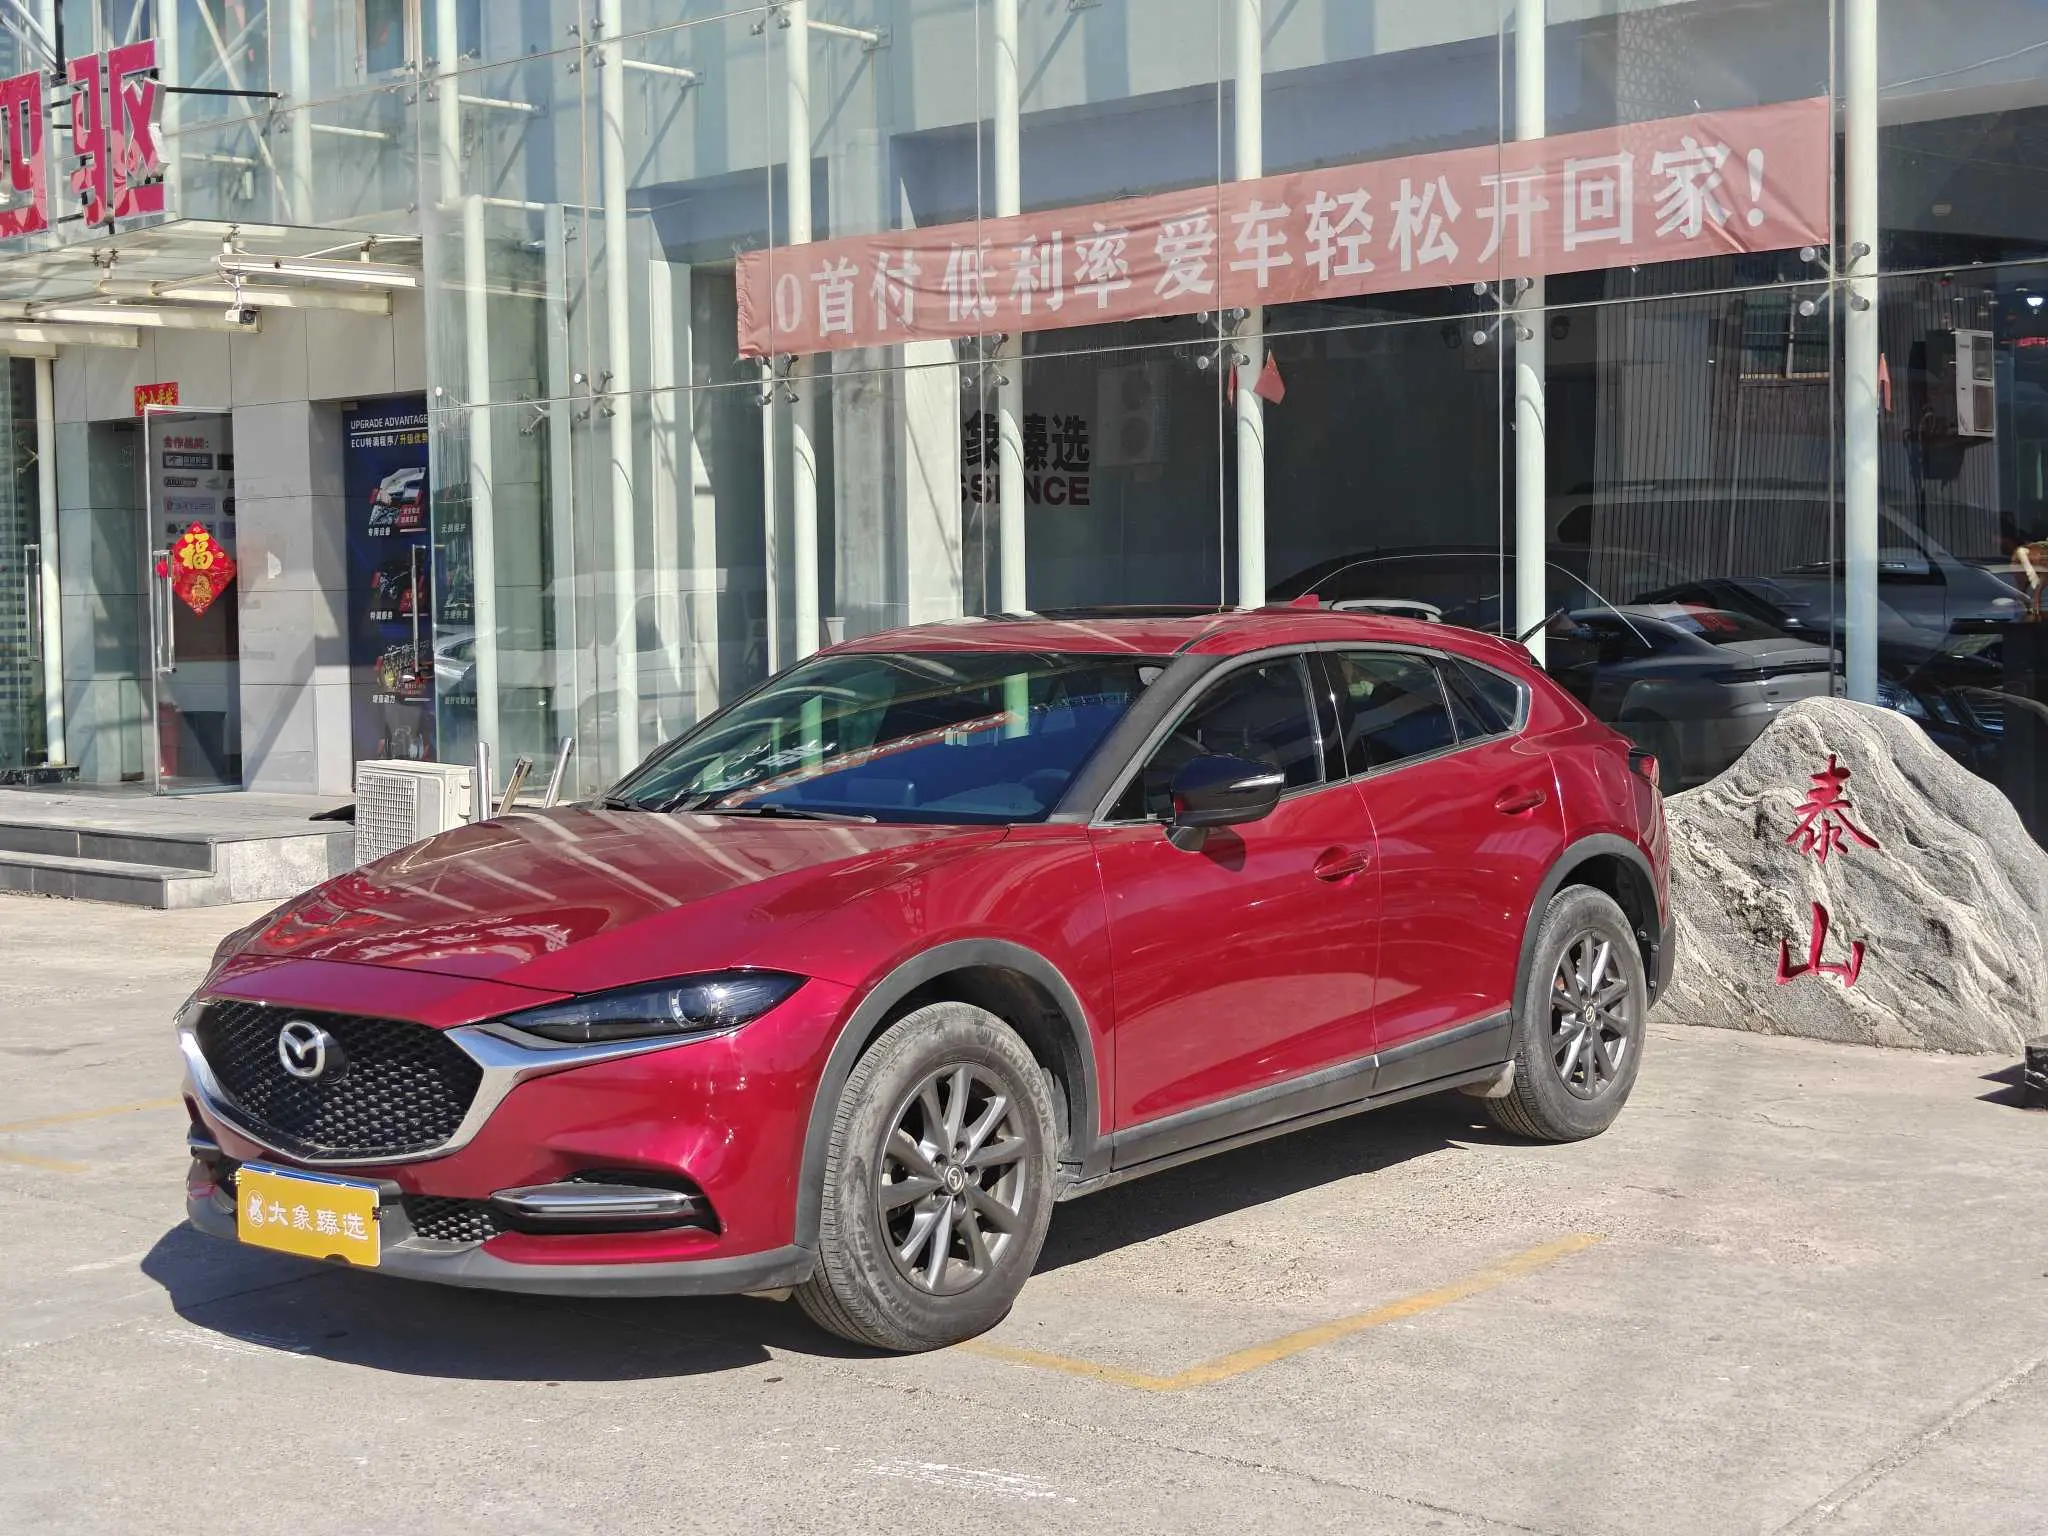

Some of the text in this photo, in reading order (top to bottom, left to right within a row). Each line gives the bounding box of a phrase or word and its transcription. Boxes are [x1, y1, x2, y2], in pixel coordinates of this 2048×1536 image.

[350, 417, 383, 430] UPGRADE
[179, 533, 214, 570] 福
[267, 1200, 369, 1241] 大象臻选
